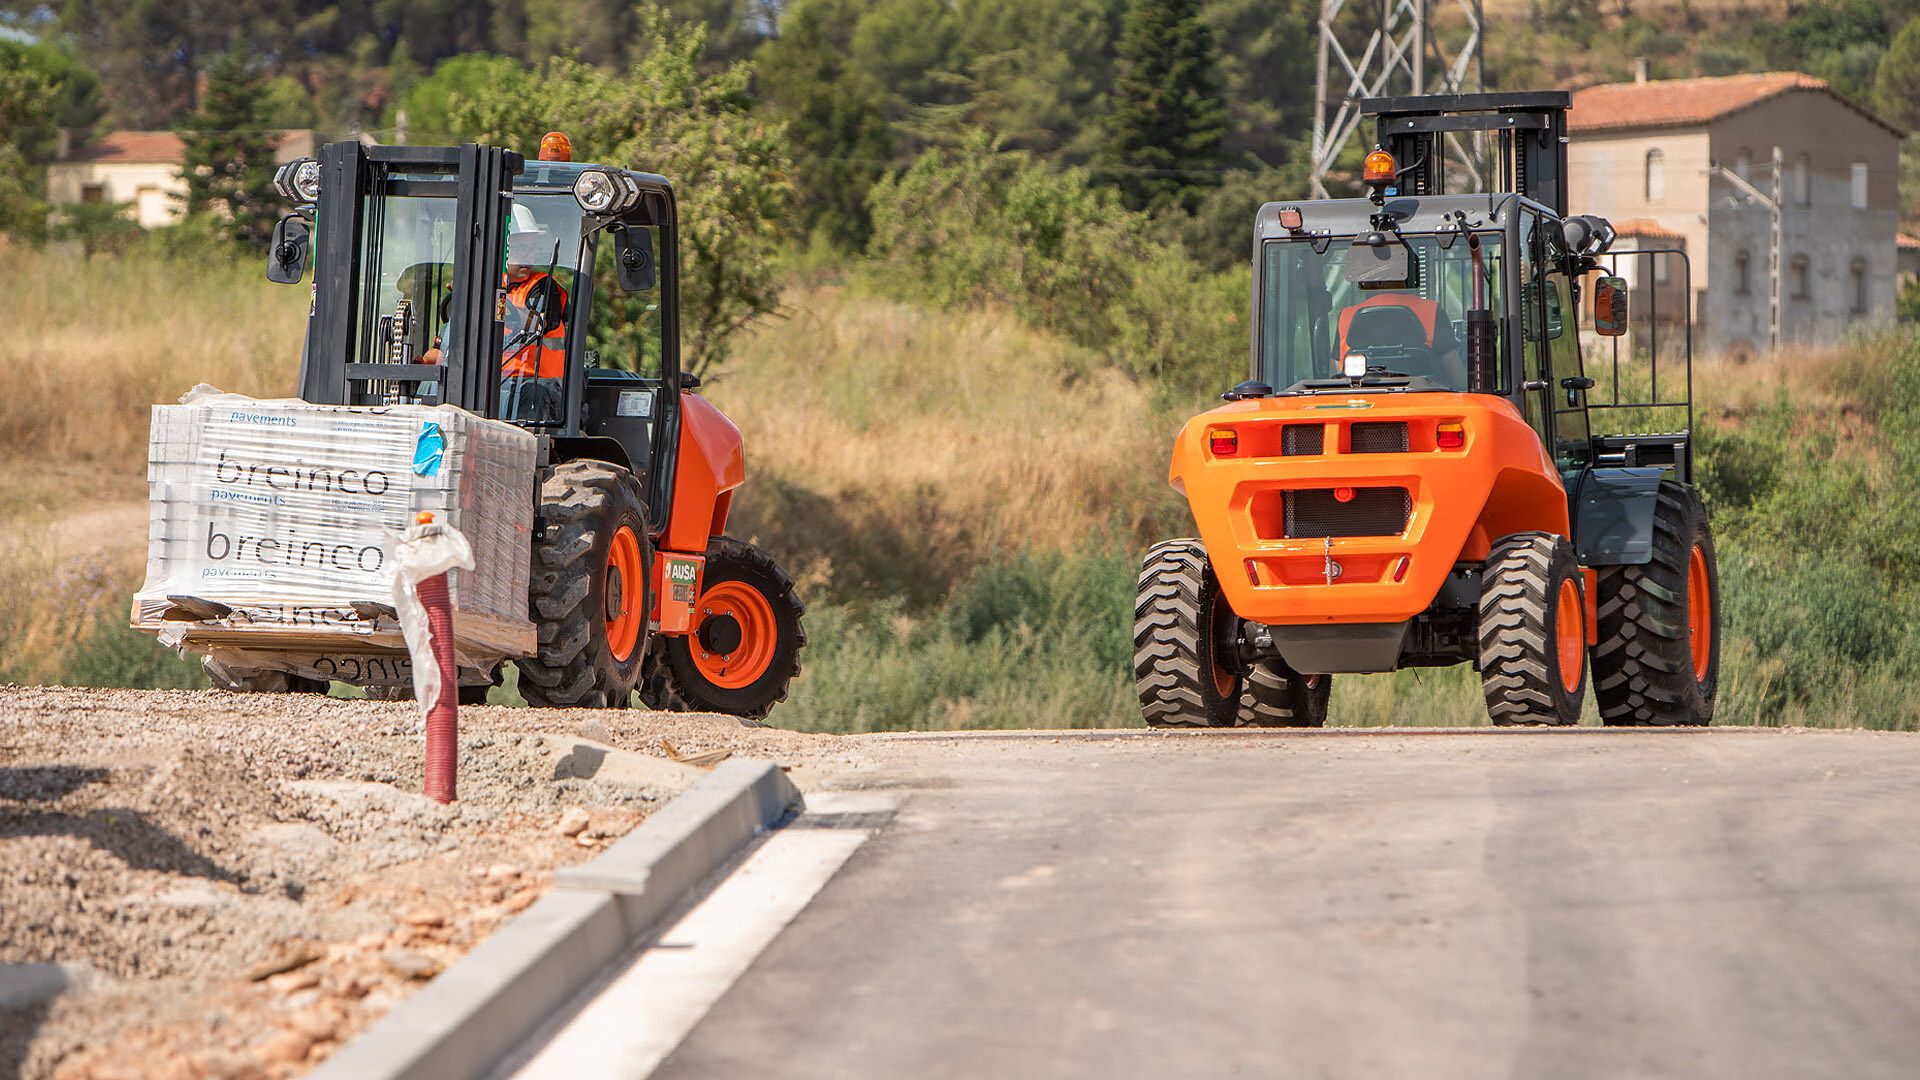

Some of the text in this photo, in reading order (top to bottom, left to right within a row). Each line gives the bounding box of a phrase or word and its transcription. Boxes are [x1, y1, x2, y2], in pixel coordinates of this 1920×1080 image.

[230, 410, 297, 427] pavements
[216, 448, 390, 496] breinco
[206, 521, 385, 573] breinco
[671, 563, 697, 581] AUSA
